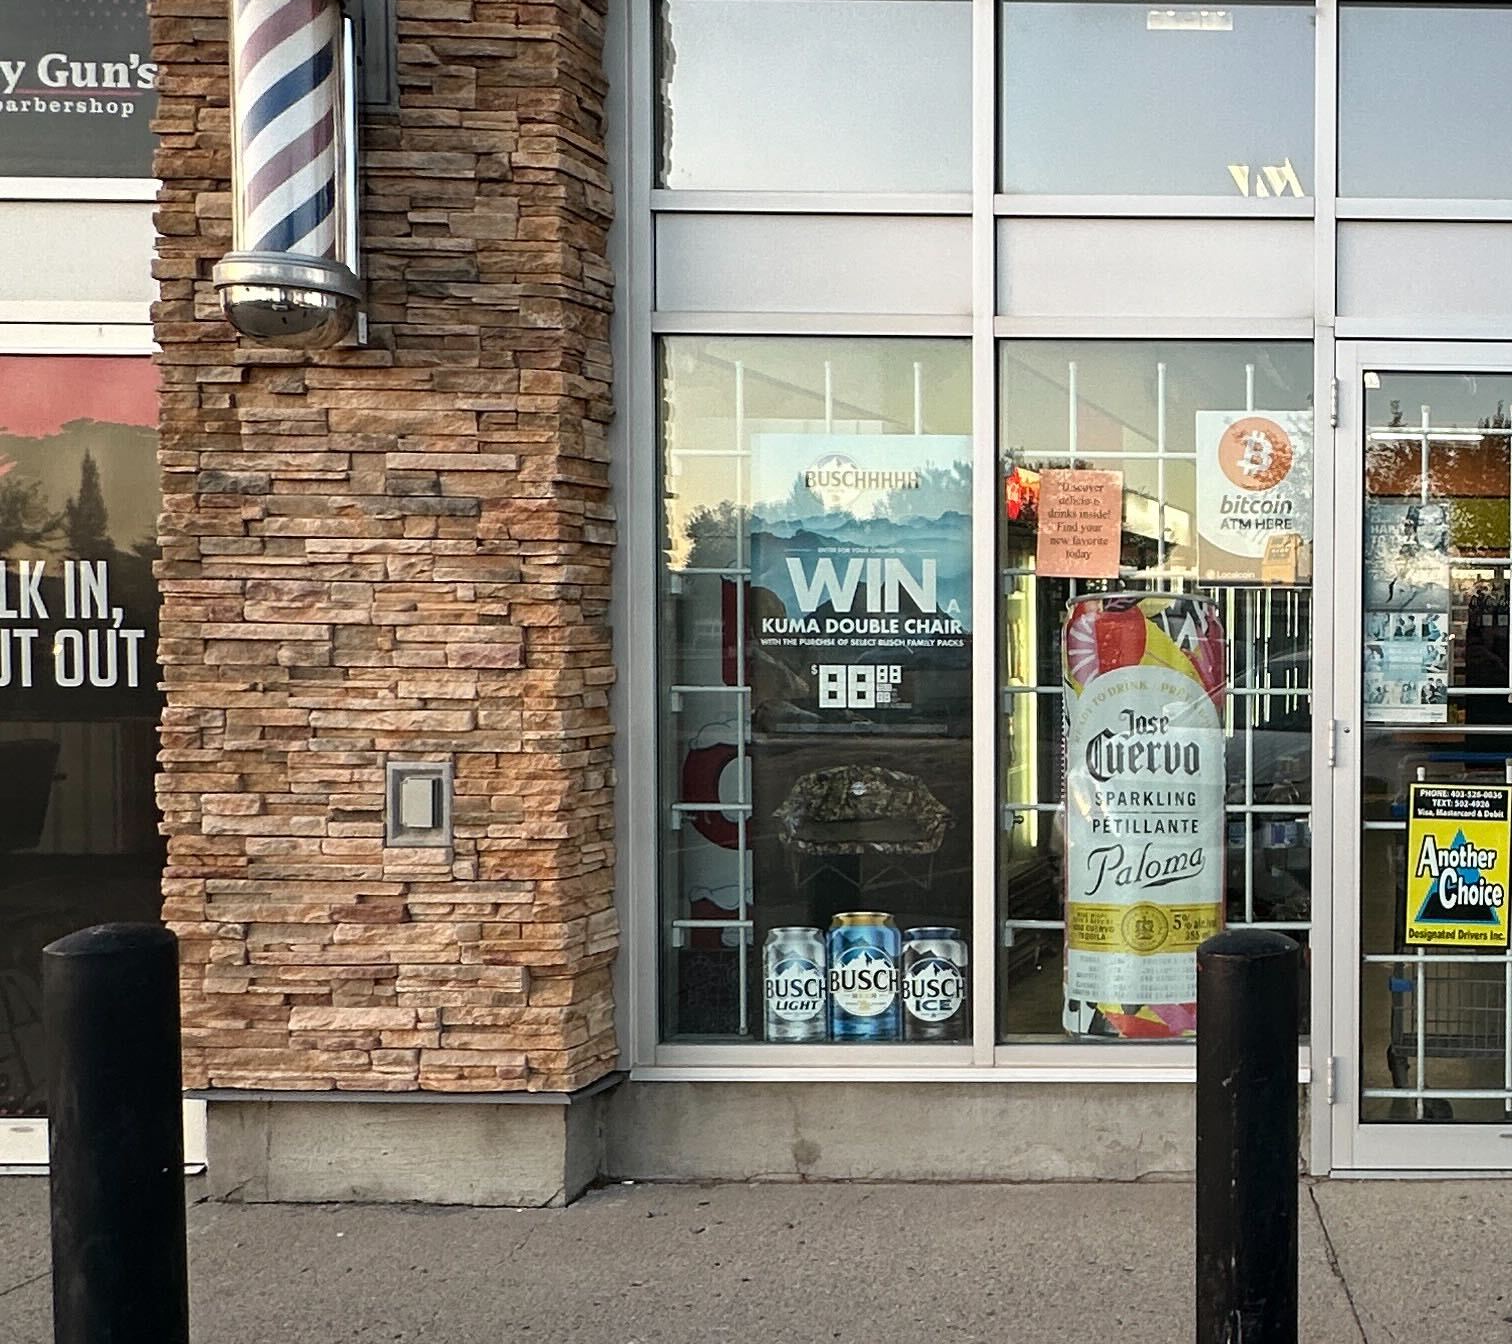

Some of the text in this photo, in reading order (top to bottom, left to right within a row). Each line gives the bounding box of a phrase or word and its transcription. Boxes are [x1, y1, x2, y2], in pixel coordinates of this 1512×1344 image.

[37, 53, 158, 89] Gun's
[0, 97, 134, 118] arbershop
[1220, 494, 1293, 515] bitcoin
[1057, 522, 1103, 534] Find your
[1220, 518, 1293, 530] ATM HERE
[1072, 536, 1108, 545] favorite
[64, 560, 123, 628] IN,
[785, 558, 961, 614] WIN A
[762, 618, 963, 635] KUMA DOUBLE CHAIR
[54, 628, 145, 687] OUT
[1119, 708, 1170, 740] Jose
[1085, 727, 1201, 783] Cuervo
[1095, 791, 1197, 807] SPARKLING
[1420, 788, 1450, 798] PHONE:
[1432, 798, 1453, 808] TEXT:
[1436, 808, 1477, 818] Mastercard
[1484, 810, 1505, 819] Debit
[1092, 815, 1200, 834] PÉTILLANTE
[1416, 835, 1497, 877] Another
[1084, 842, 1206, 896] Paloma
[1439, 867, 1504, 910] Choice
[1408, 928, 1506, 942] Designated Drivers Inc.
[766, 979, 826, 1000] BUSCH
[830, 969, 900, 992] BUSCH
[903, 978, 966, 1000] BUSCH
[776, 1000, 818, 1011] LIGHT
[915, 1000, 952, 1011] ICE
